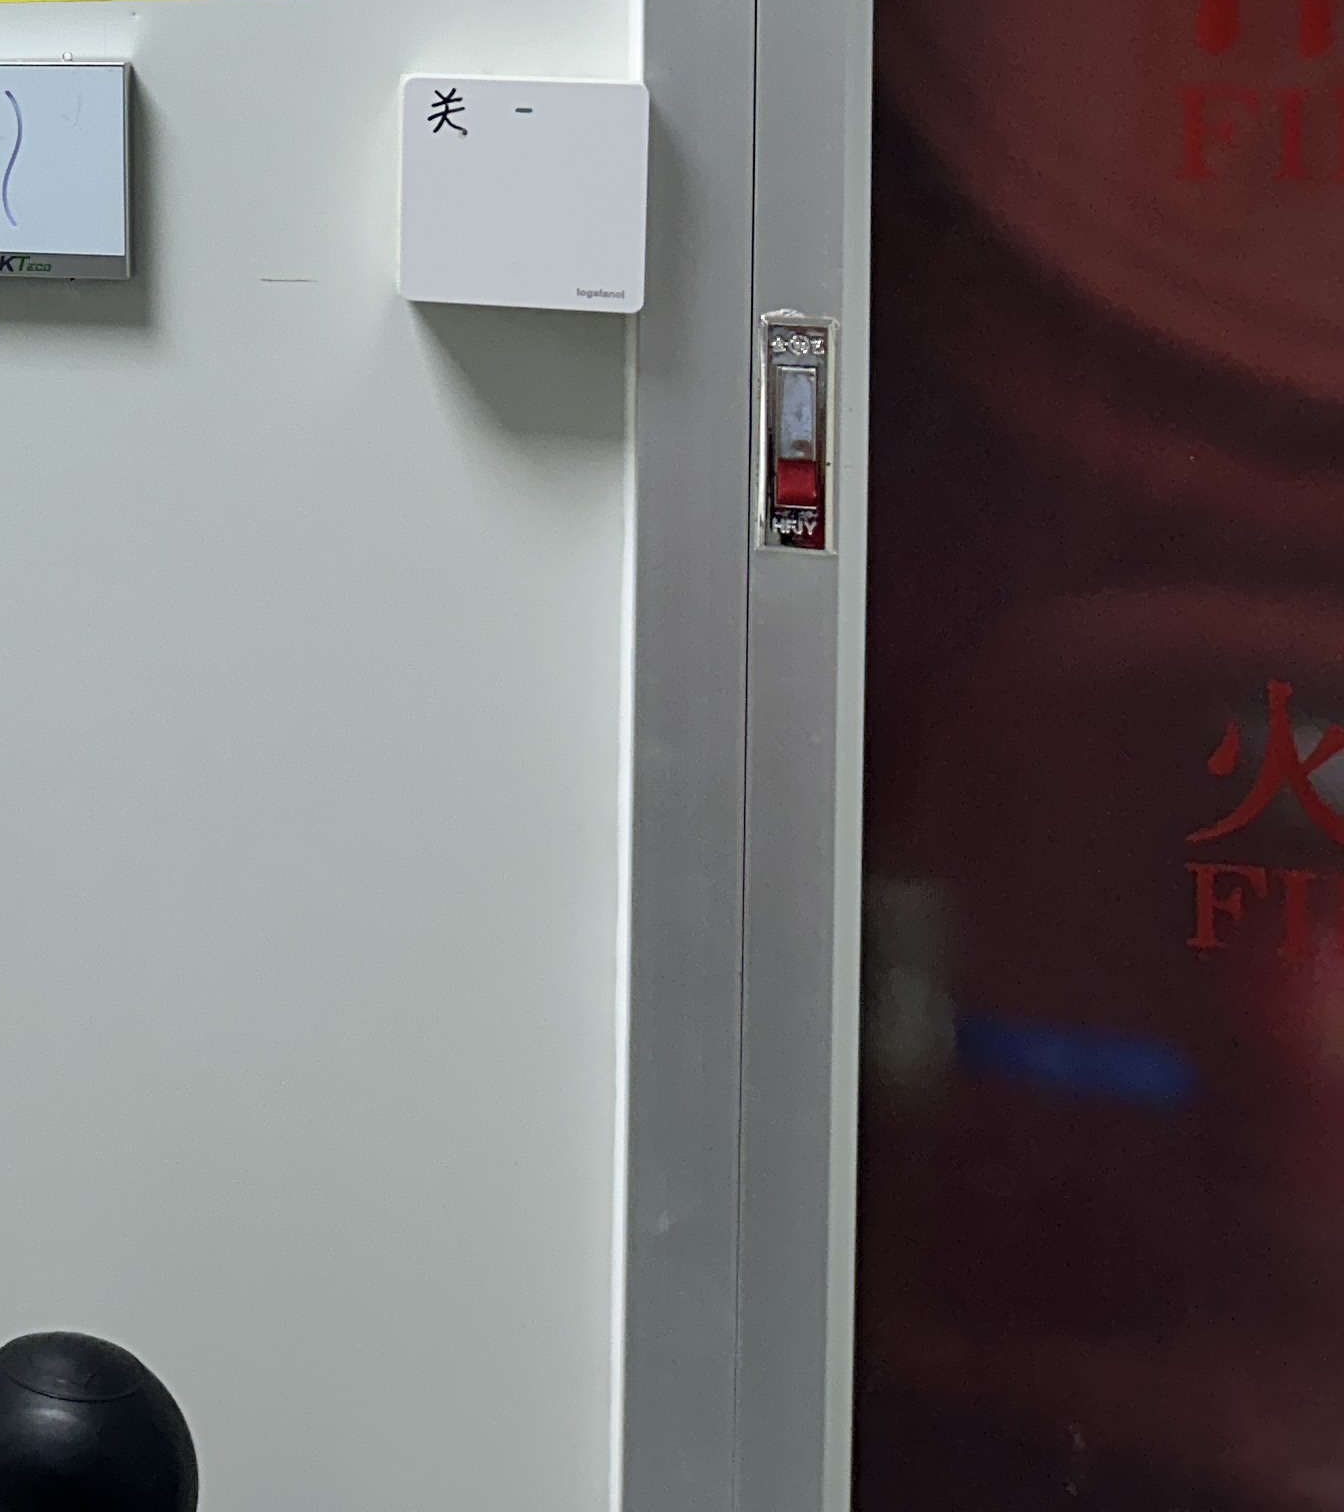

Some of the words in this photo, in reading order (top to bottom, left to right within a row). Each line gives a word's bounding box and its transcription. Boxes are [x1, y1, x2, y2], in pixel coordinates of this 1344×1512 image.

[427, 88, 468, 136] 关
[1174, 87, 1344, 180] FI
[1184, 679, 1344, 846] 火
[1184, 861, 1344, 959] FI
